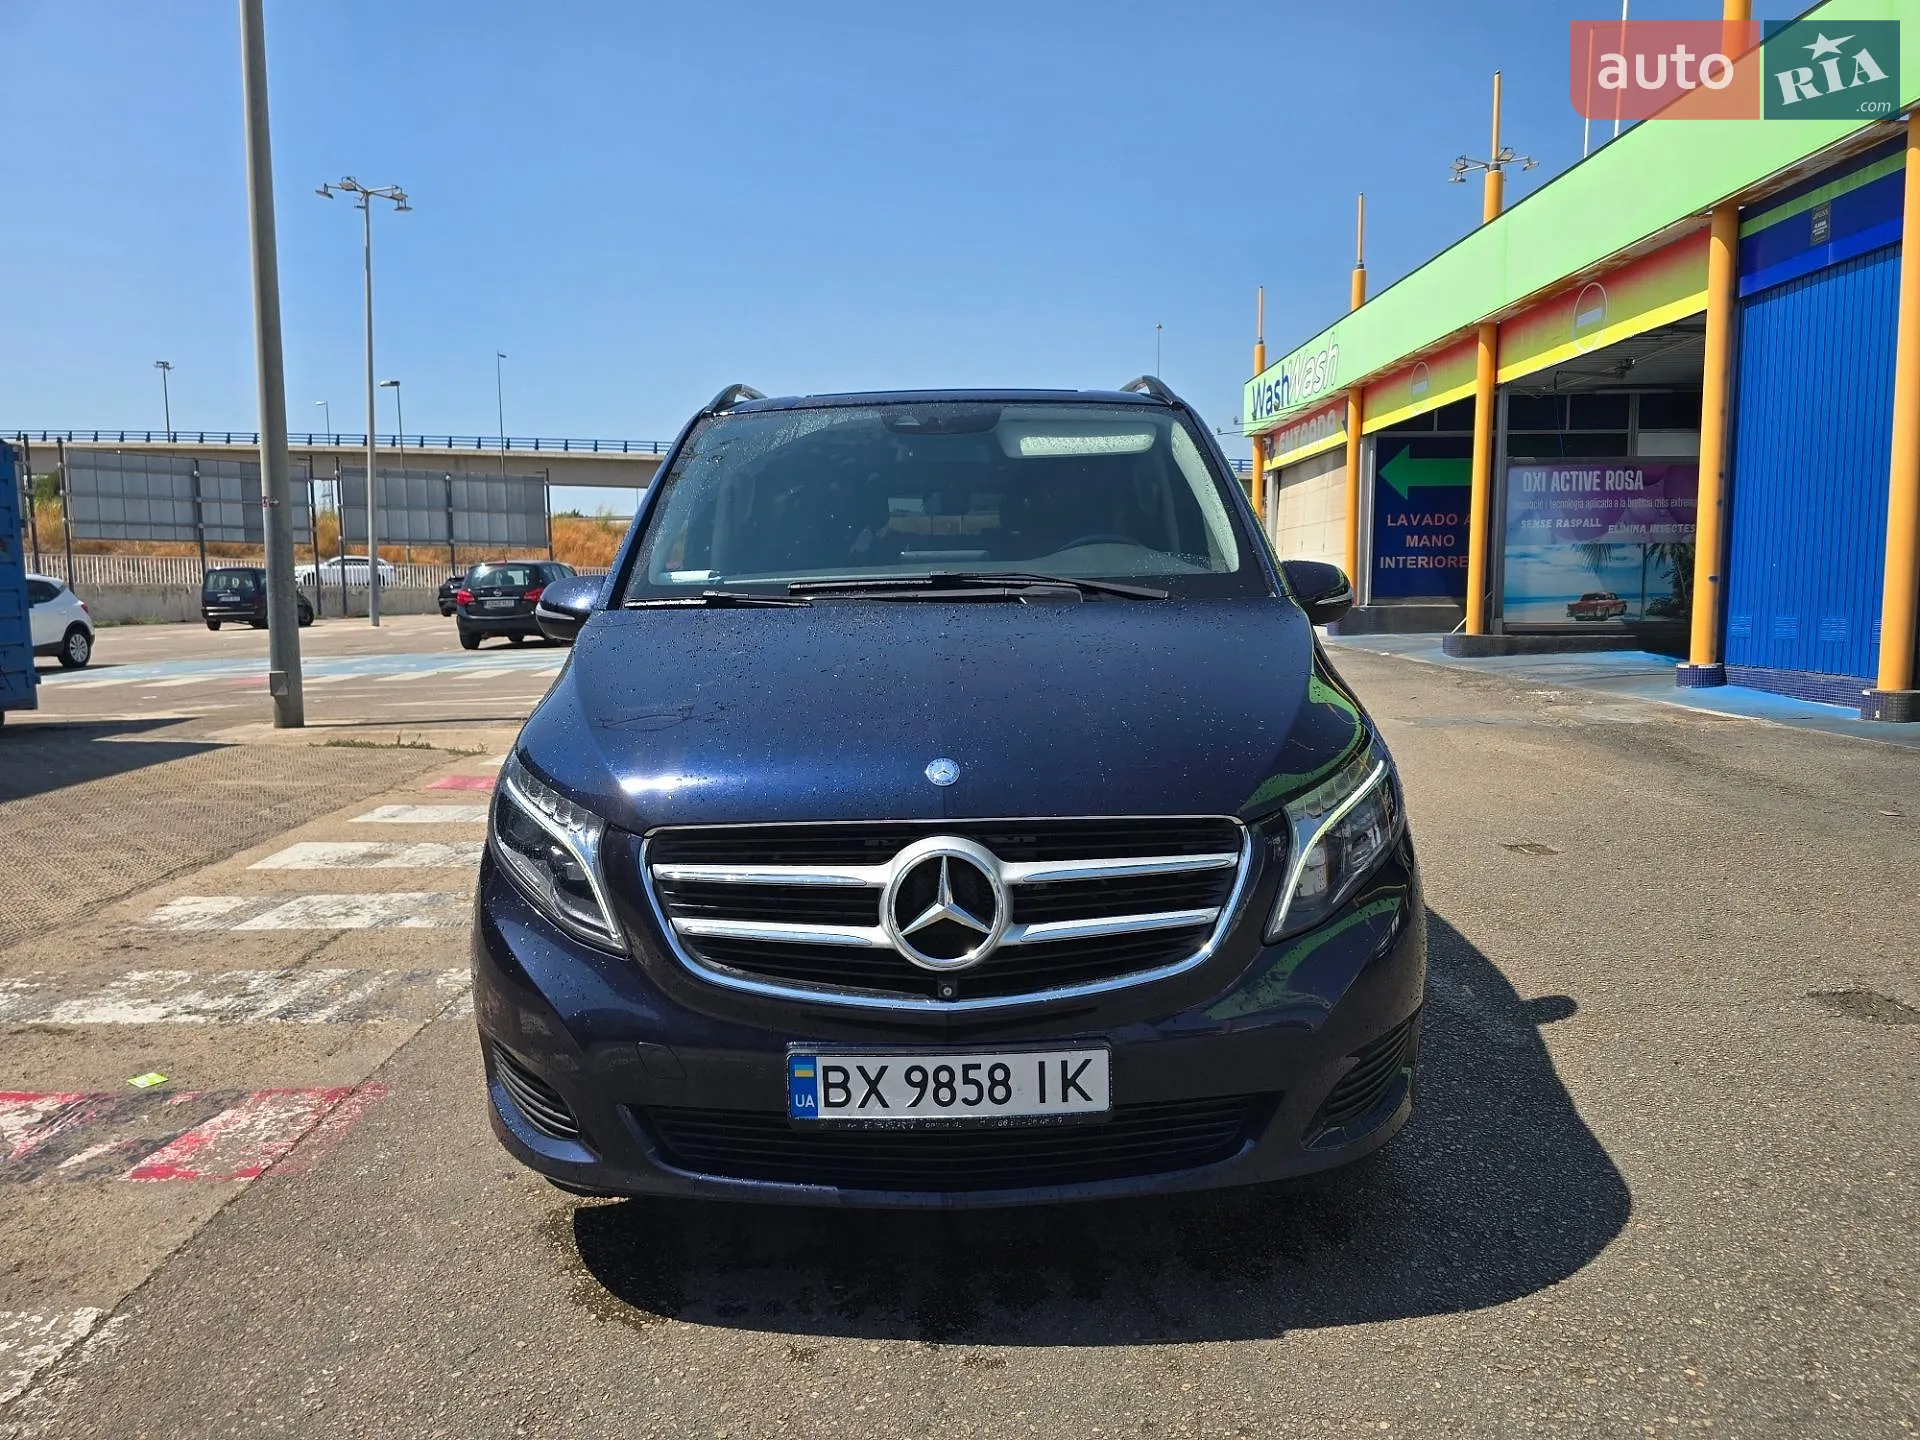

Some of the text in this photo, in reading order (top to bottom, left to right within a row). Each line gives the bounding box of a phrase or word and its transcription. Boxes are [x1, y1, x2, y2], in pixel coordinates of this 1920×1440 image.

[1523, 470, 1644, 492] OXI ACTIVE ROSA
[1387, 513, 1458, 526] LAVADO
[1556, 518, 1602, 528] RASPALL
[1405, 534, 1456, 547] MANO
[1380, 555, 1469, 568] INTERIORE
[822, 1058, 1094, 1108] BX 9858 IK
[795, 1093, 815, 1108] UA
